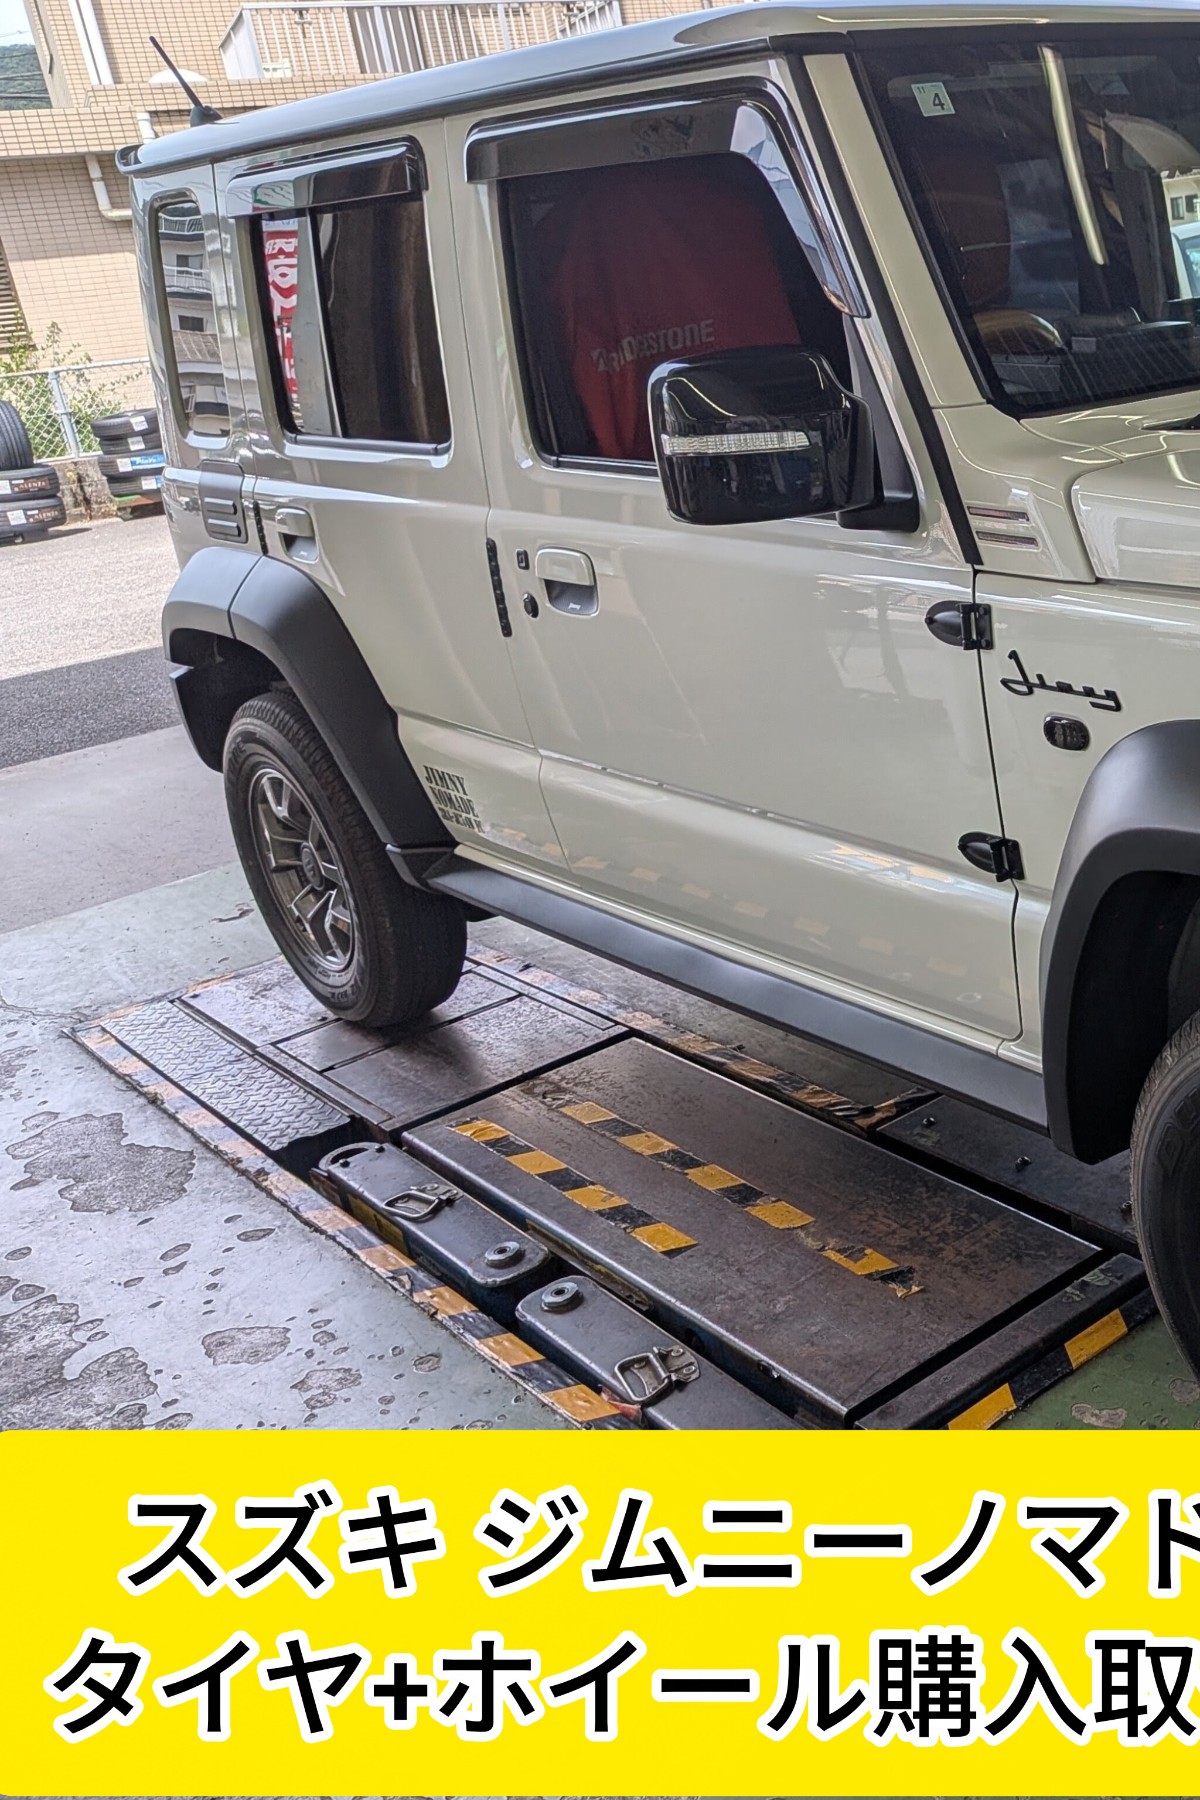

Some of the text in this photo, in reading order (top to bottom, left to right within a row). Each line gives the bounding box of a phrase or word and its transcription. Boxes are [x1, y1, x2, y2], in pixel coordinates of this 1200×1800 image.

[932, 92, 945, 110] 4
[999, 649, 1122, 713] Jimny
[423, 764, 469, 796] JIMNY
[428, 784, 480, 819] NOMADE
